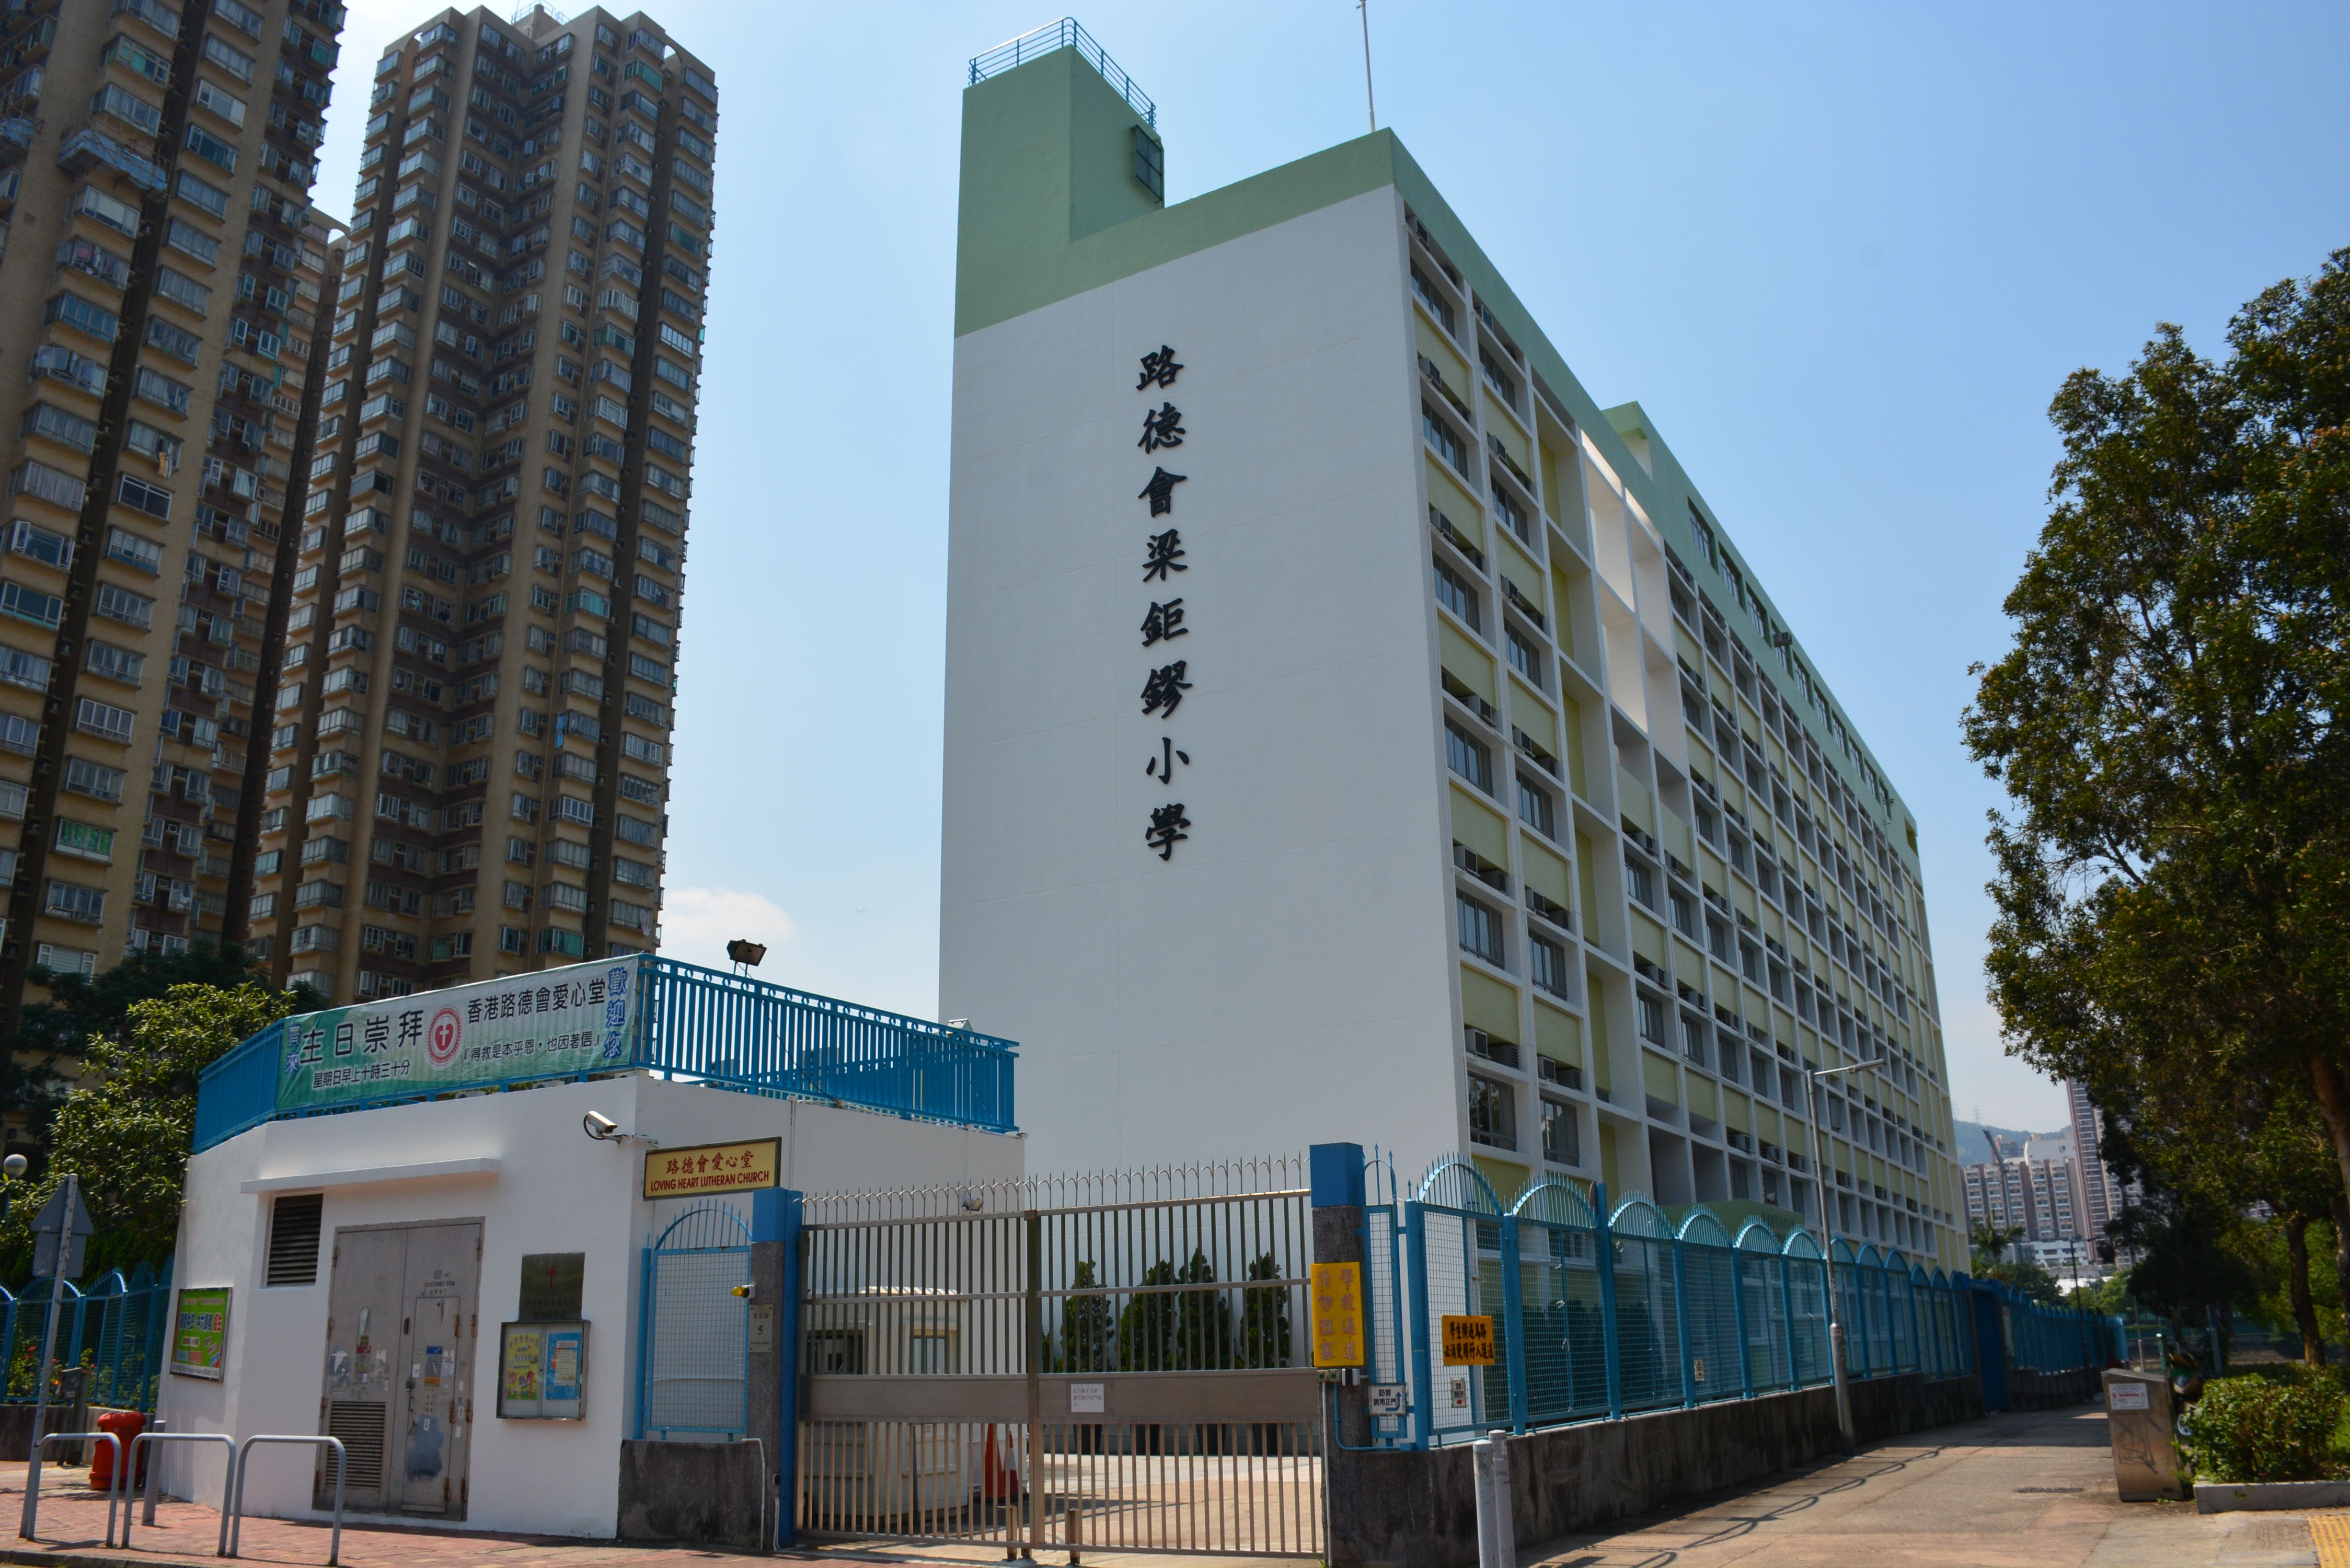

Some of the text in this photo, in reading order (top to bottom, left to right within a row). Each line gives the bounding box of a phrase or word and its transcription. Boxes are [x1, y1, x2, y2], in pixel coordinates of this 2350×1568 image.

[1136, 344, 1193, 861] 路德會梁鉅鏐小學
[468, 978, 605, 1024] 香港路德會愛心堂
[604, 967, 627, 1059] 歡迎您
[285, 1024, 302, 1074] 齊來
[300, 1010, 424, 1064] 主日崇拜
[313, 1059, 411, 1088] 星期日早上十時三十分
[651, 1171, 769, 1192] LOVING HEART LUTHERAN CHURCH
[666, 1150, 754, 1175] 路德會愛心堂
[758, 1325, 763, 1335] 5
[1317, 1270, 1336, 1360] 請勿阻塞
[1340, 1268, 1358, 1360] 學校通道
